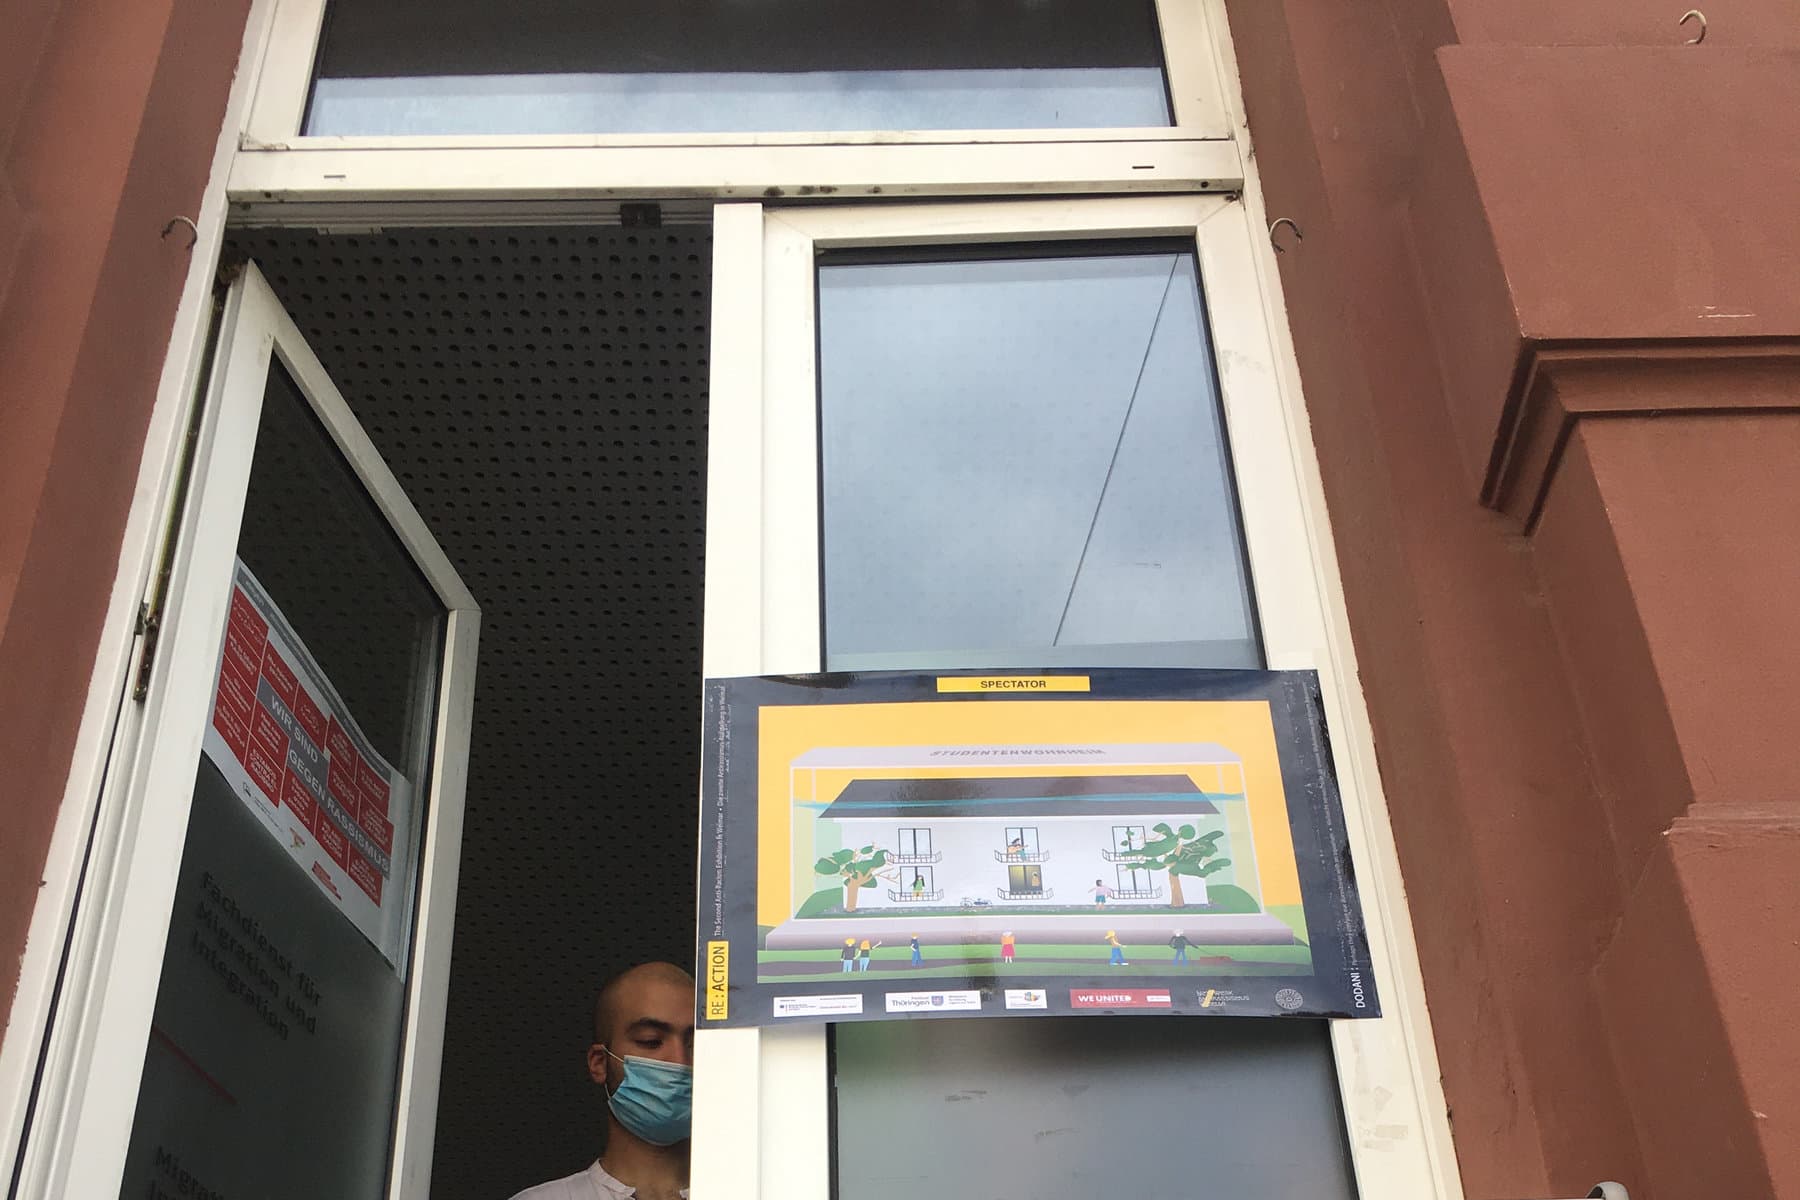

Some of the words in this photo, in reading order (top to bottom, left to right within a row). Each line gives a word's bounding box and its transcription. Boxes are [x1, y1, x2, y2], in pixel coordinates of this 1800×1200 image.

[980, 680, 1047, 689] SPECTATOR
[271, 695, 292, 731] WIR
[294, 727, 318, 762] SIND
[289, 749, 326, 801] GEGEN
[327, 796, 389, 872] RASSISMUS
[202, 871, 296, 977] Fachdienst
[714, 903, 722, 925] Second
[192, 928, 288, 1040] Integration
[195, 900, 279, 997] Migration
[286, 994, 316, 1034] und
[1350, 972, 1365, 1008] DODANI
